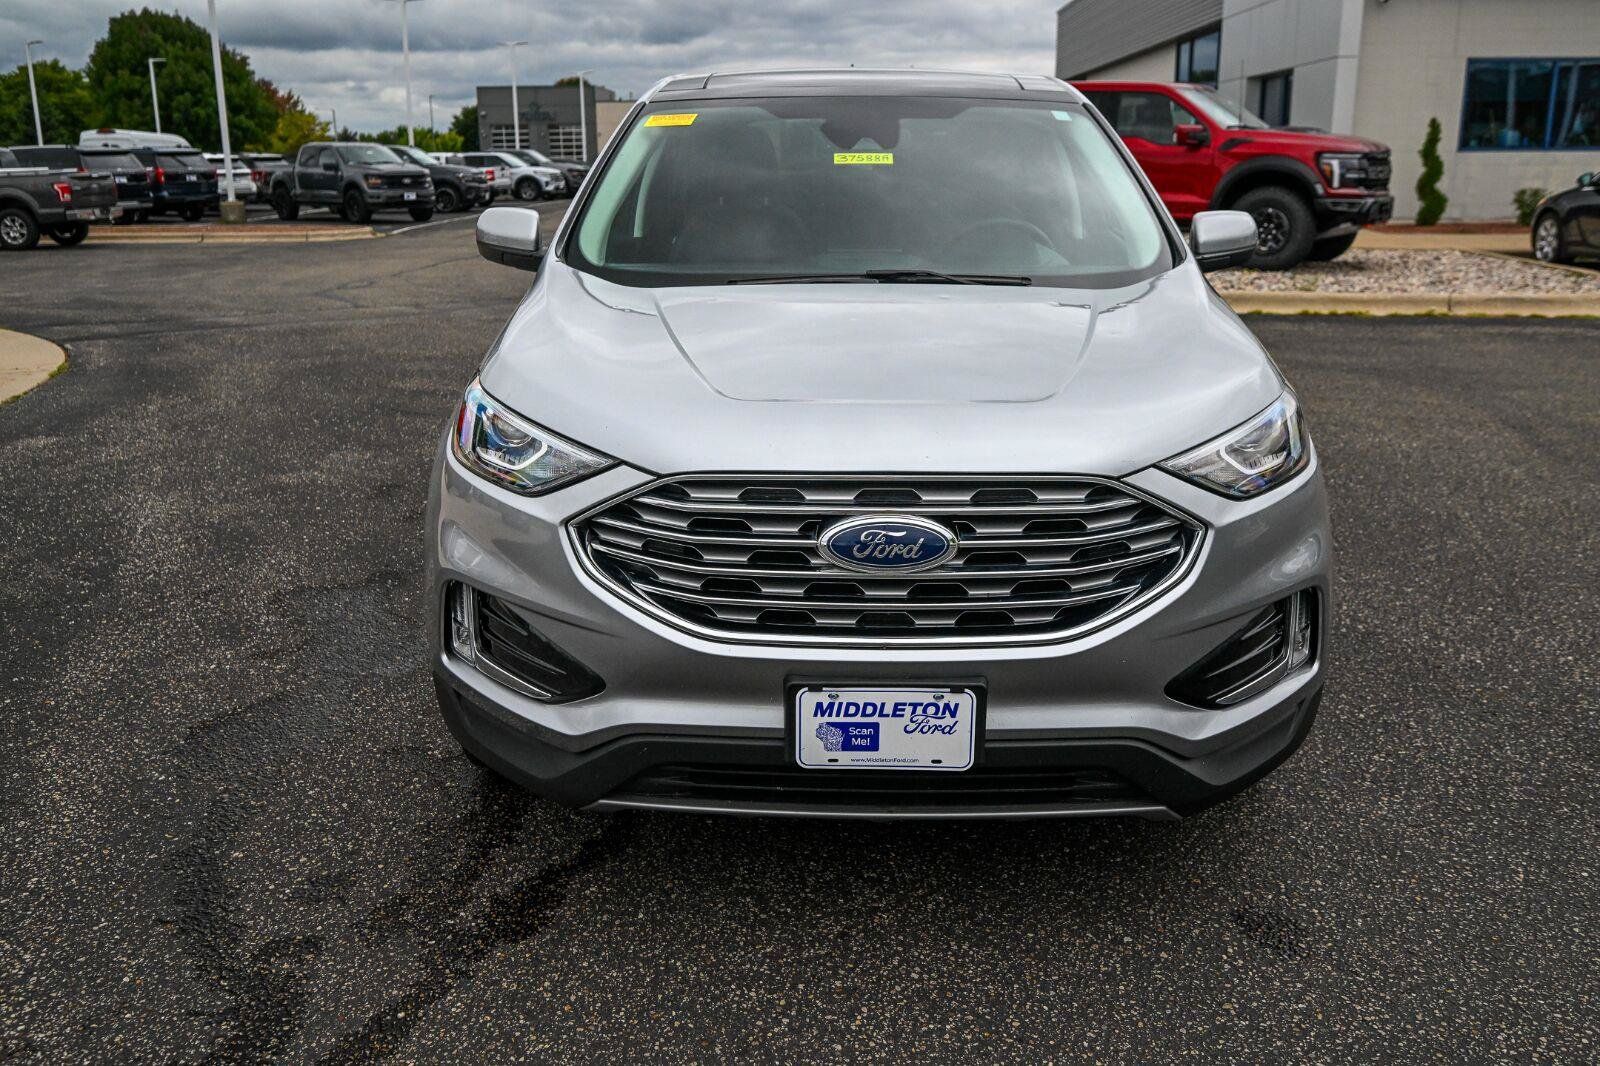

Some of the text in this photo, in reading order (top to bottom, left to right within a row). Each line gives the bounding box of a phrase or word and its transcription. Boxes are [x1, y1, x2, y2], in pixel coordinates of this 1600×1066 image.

[852, 529, 925, 559] Ford
[813, 701, 960, 718] MIDDLETON
[848, 726, 874, 735] Scan
[903, 714, 959, 735] Ford
[851, 737, 870, 746] Me!
